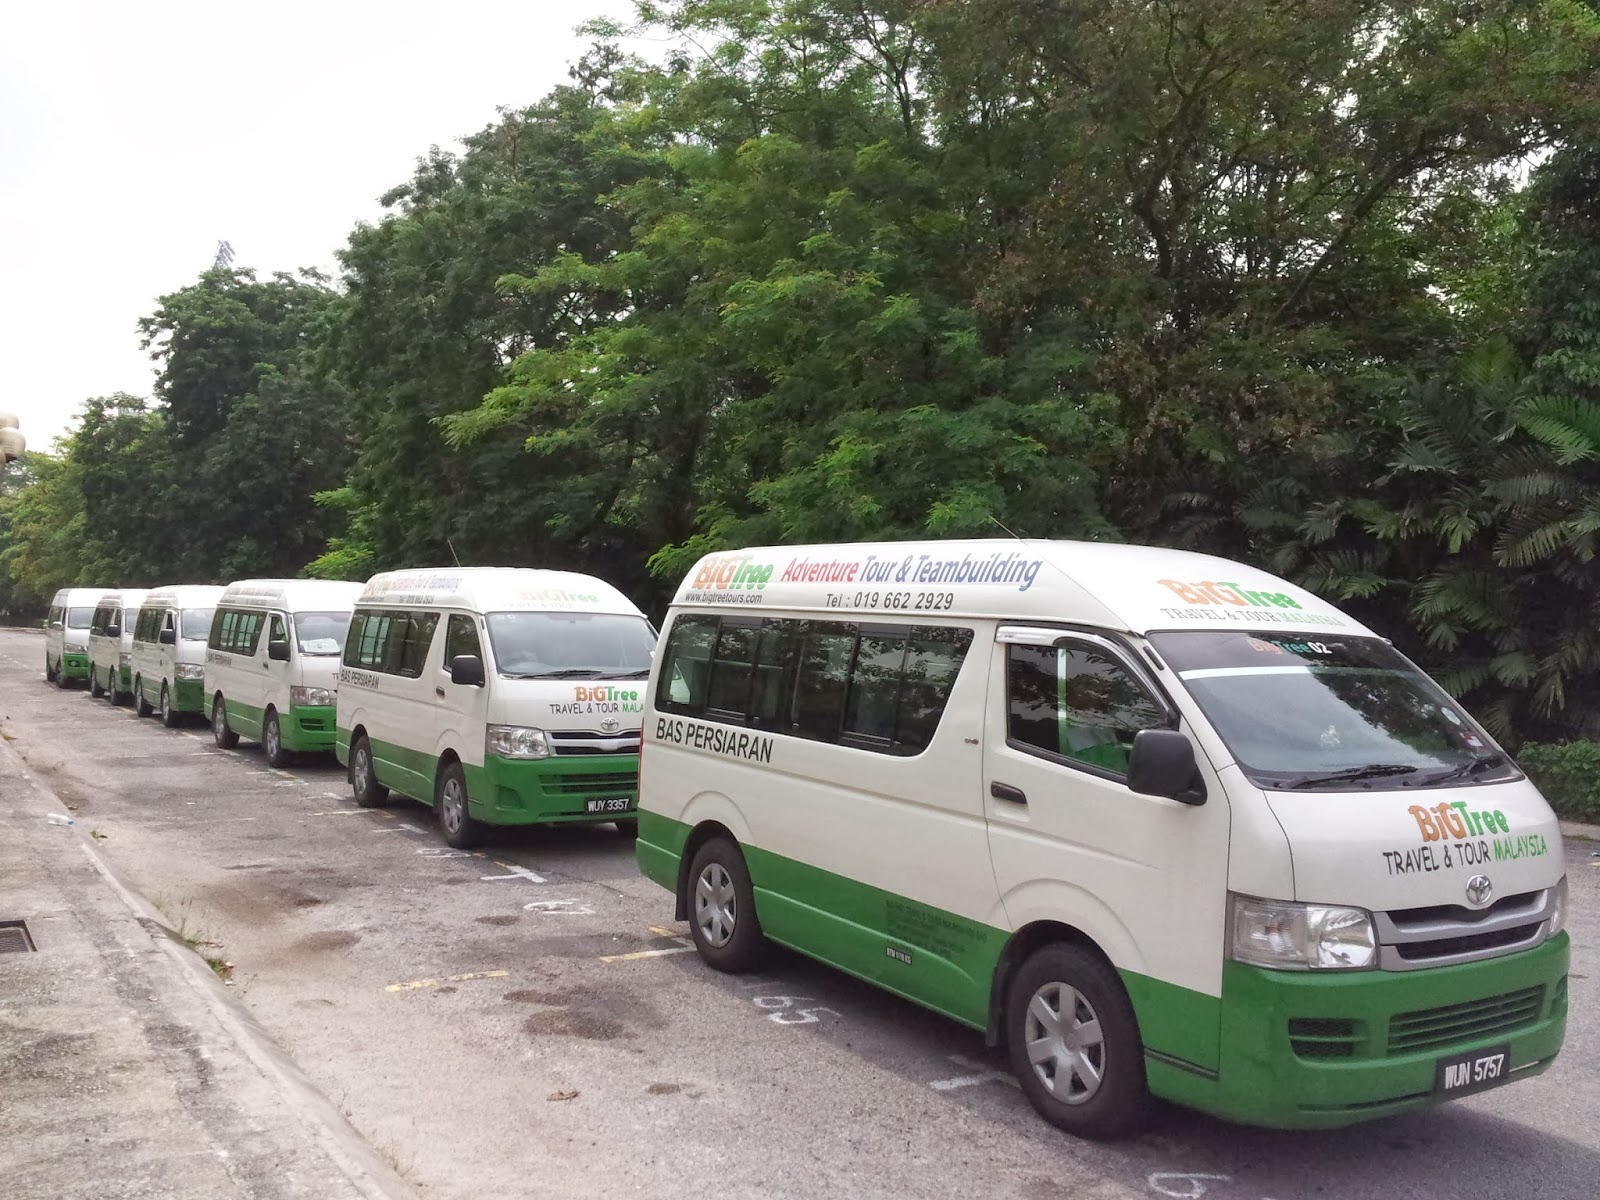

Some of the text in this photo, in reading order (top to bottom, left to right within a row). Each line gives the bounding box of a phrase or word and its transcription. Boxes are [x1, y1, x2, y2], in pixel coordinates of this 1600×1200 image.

[781, 557, 860, 582] Adventure
[860, 555, 898, 582] Tour
[895, 555, 914, 582] &
[912, 552, 1043, 591] Teambuilding
[685, 591, 762, 604] www.bigtreetours.com
[826, 593, 844, 608] Tel
[854, 592, 880, 608] 019
[883, 592, 911, 609] 662
[915, 593, 954, 610] 2929
[1160, 608, 1224, 620] TRAVEL
[1226, 609, 1239, 621] &
[1239, 611, 1284, 623] TOUR
[549, 703, 584, 715] TRAVEL
[586, 703, 593, 714] &
[596, 702, 619, 714] TOUR
[656, 717, 774, 764] BAS PERSIARAN
[587, 798, 630, 812] WUY 3357
[1383, 833, 1548, 875] TRAVEL & TOUR MALAYSIA
[1445, 1053, 1505, 1090] WUN 5757
